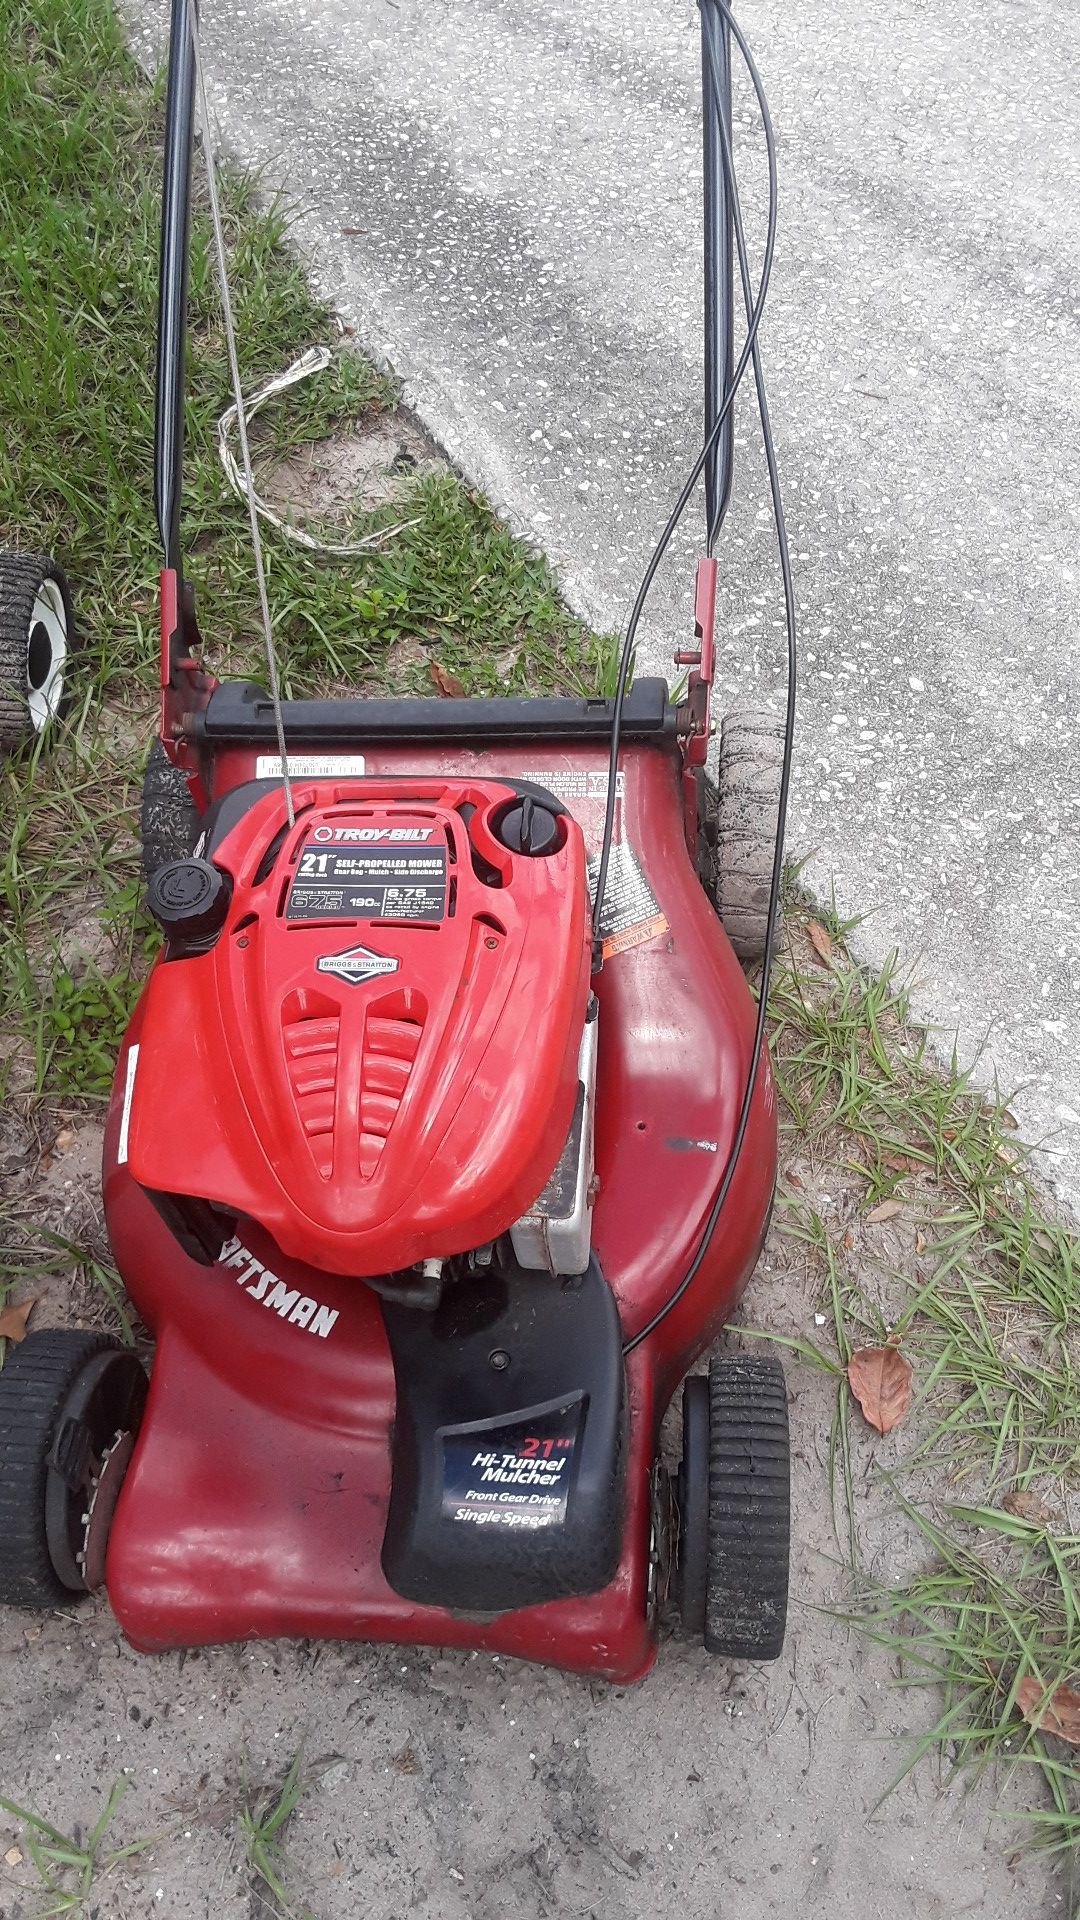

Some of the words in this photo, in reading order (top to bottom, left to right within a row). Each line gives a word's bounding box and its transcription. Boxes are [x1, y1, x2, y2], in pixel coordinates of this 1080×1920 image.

[334, 828, 434, 841] TROY-BILT
[336, 859, 407, 868] SELF-PROPELLED
[408, 859, 443, 868] MOWER
[291, 894, 343, 908] 675
[387, 888, 427, 897] 6.75
[218, 1235, 340, 1338] AFTSMAN
[519, 1437, 570, 1458] 21"
[471, 1452, 567, 1472] Hi-Tunnel
[481, 1468, 561, 1486] Mulcher
[465, 1490, 499, 1501] Front
[499, 1492, 529, 1503] Gear
[528, 1494, 562, 1506] Drive
[454, 1508, 501, 1524] Single
[501, 1511, 552, 1527] Speed
